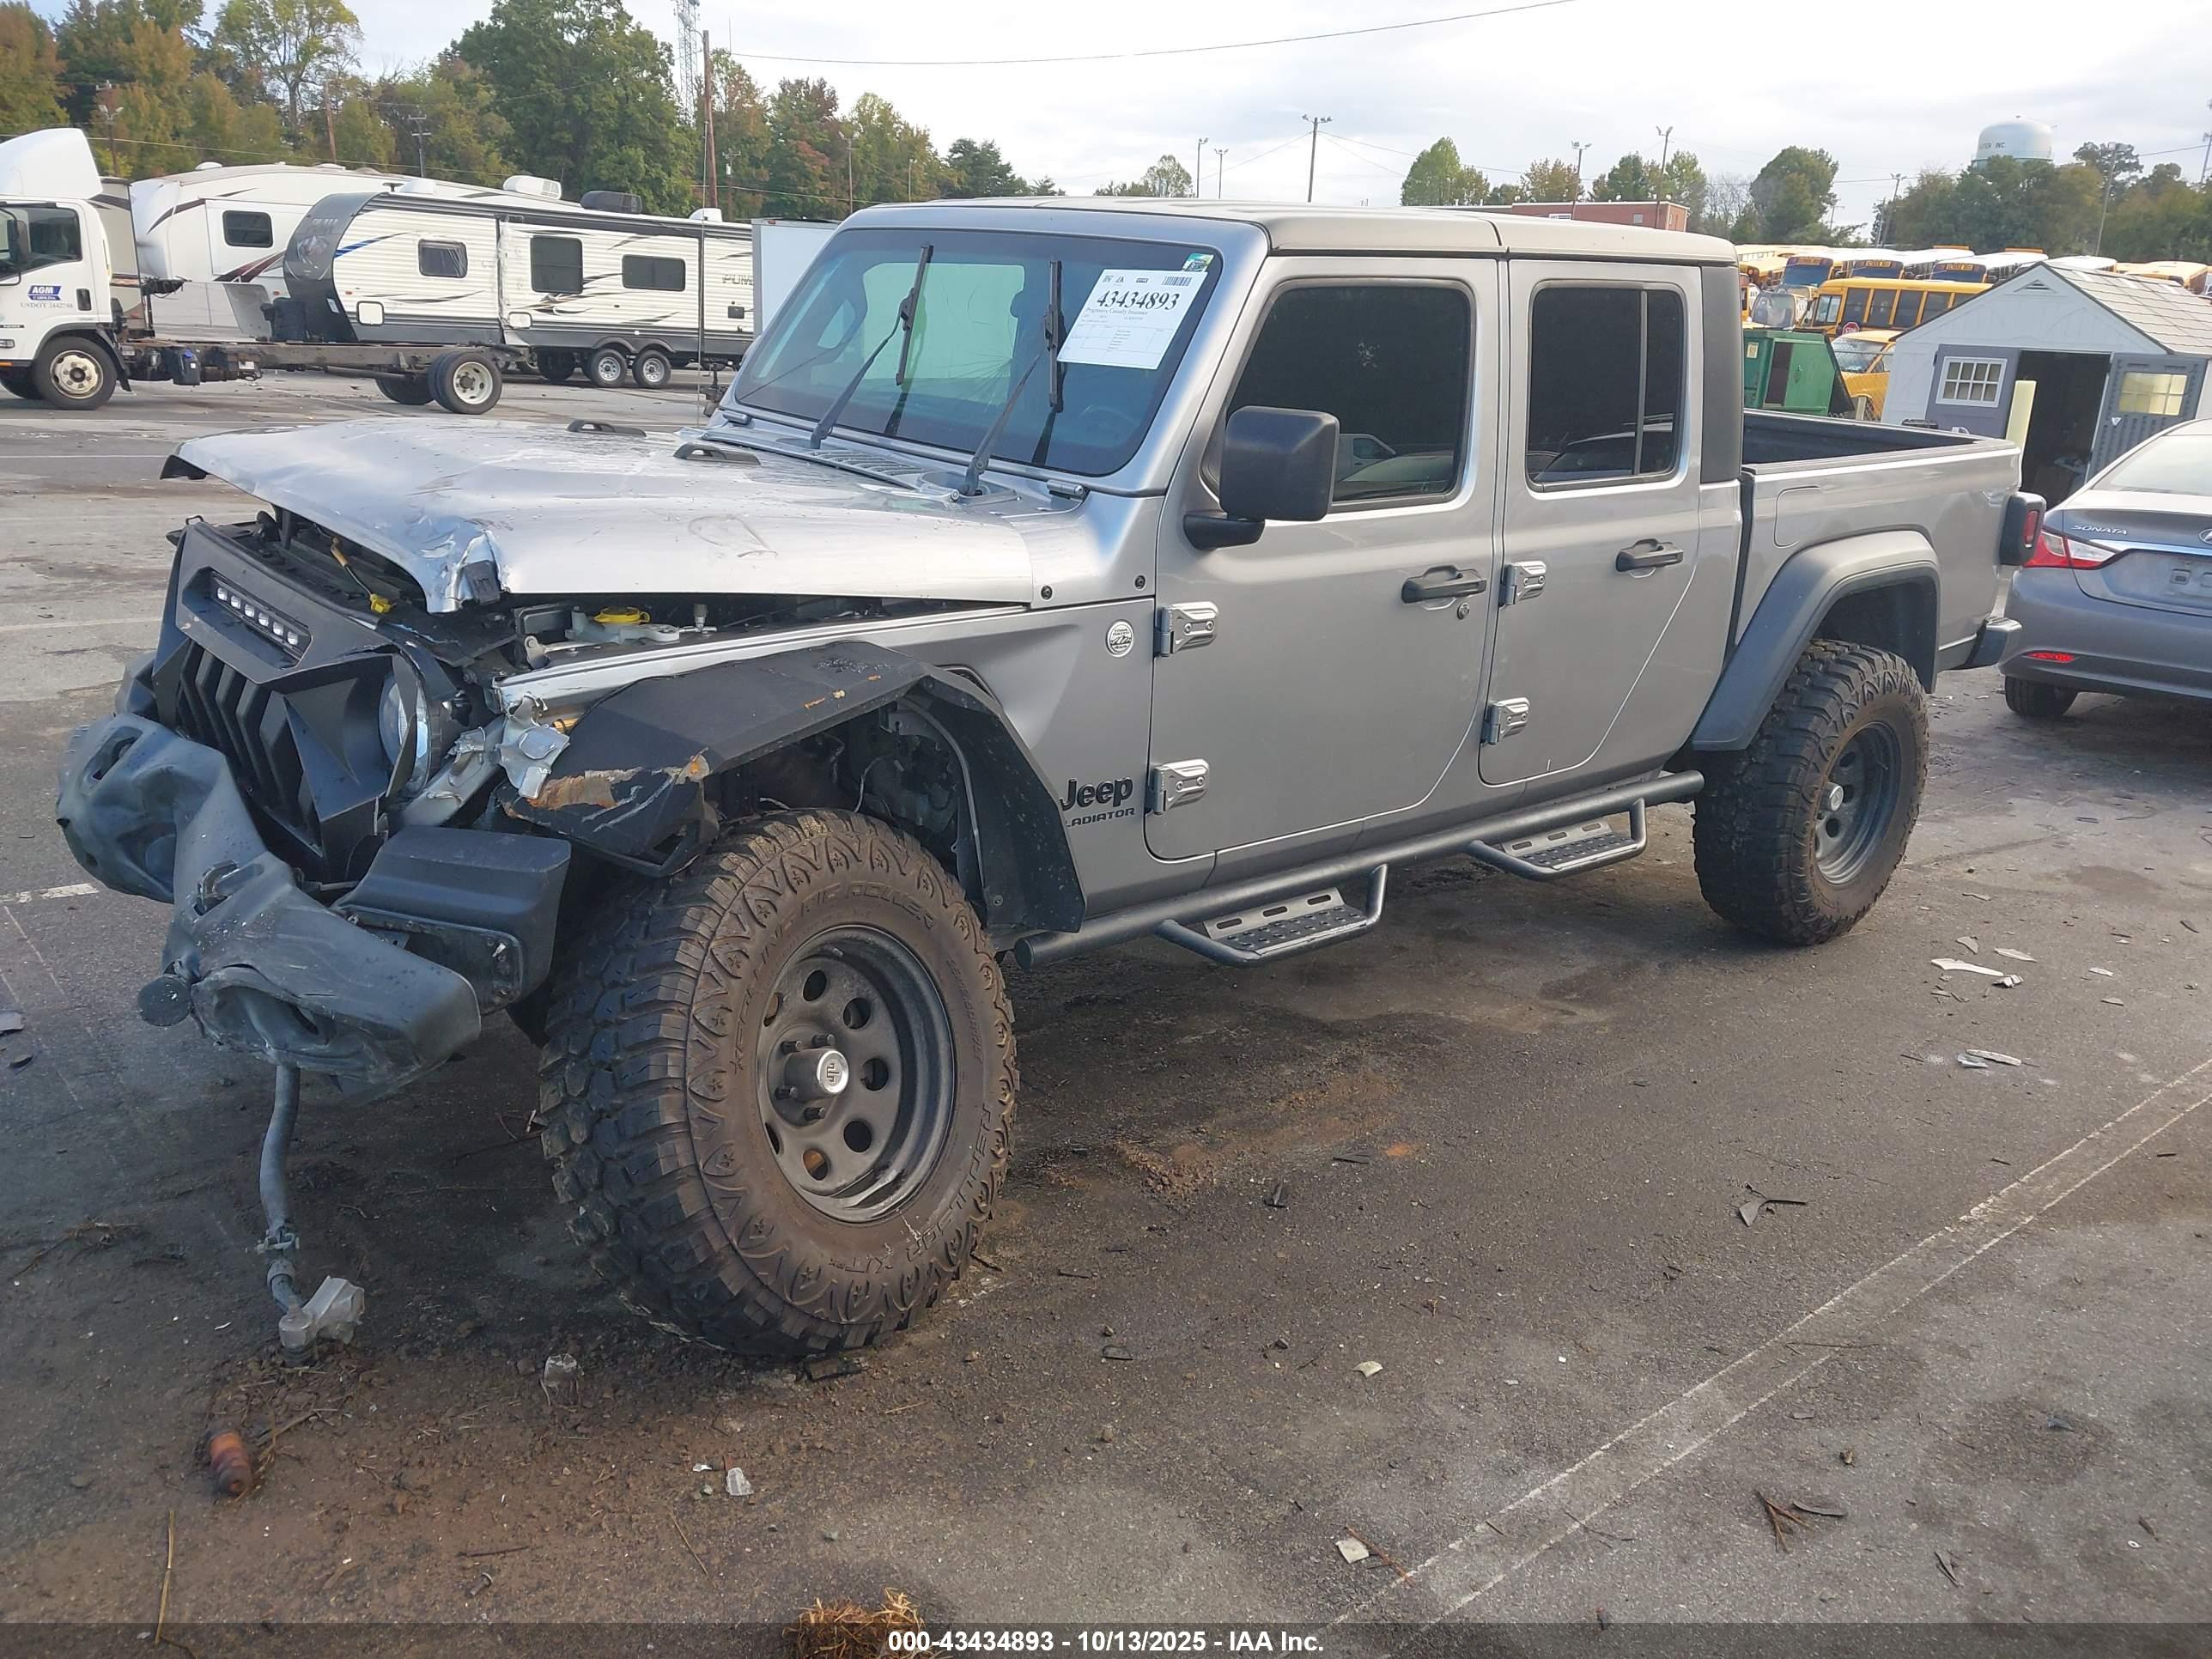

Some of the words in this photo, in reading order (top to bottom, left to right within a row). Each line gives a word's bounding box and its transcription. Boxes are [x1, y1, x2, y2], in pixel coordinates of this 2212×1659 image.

[1097, 290, 1181, 310] 43434893
[2070, 525, 2127, 534] SONATA
[1059, 776, 1133, 811] Jeep
